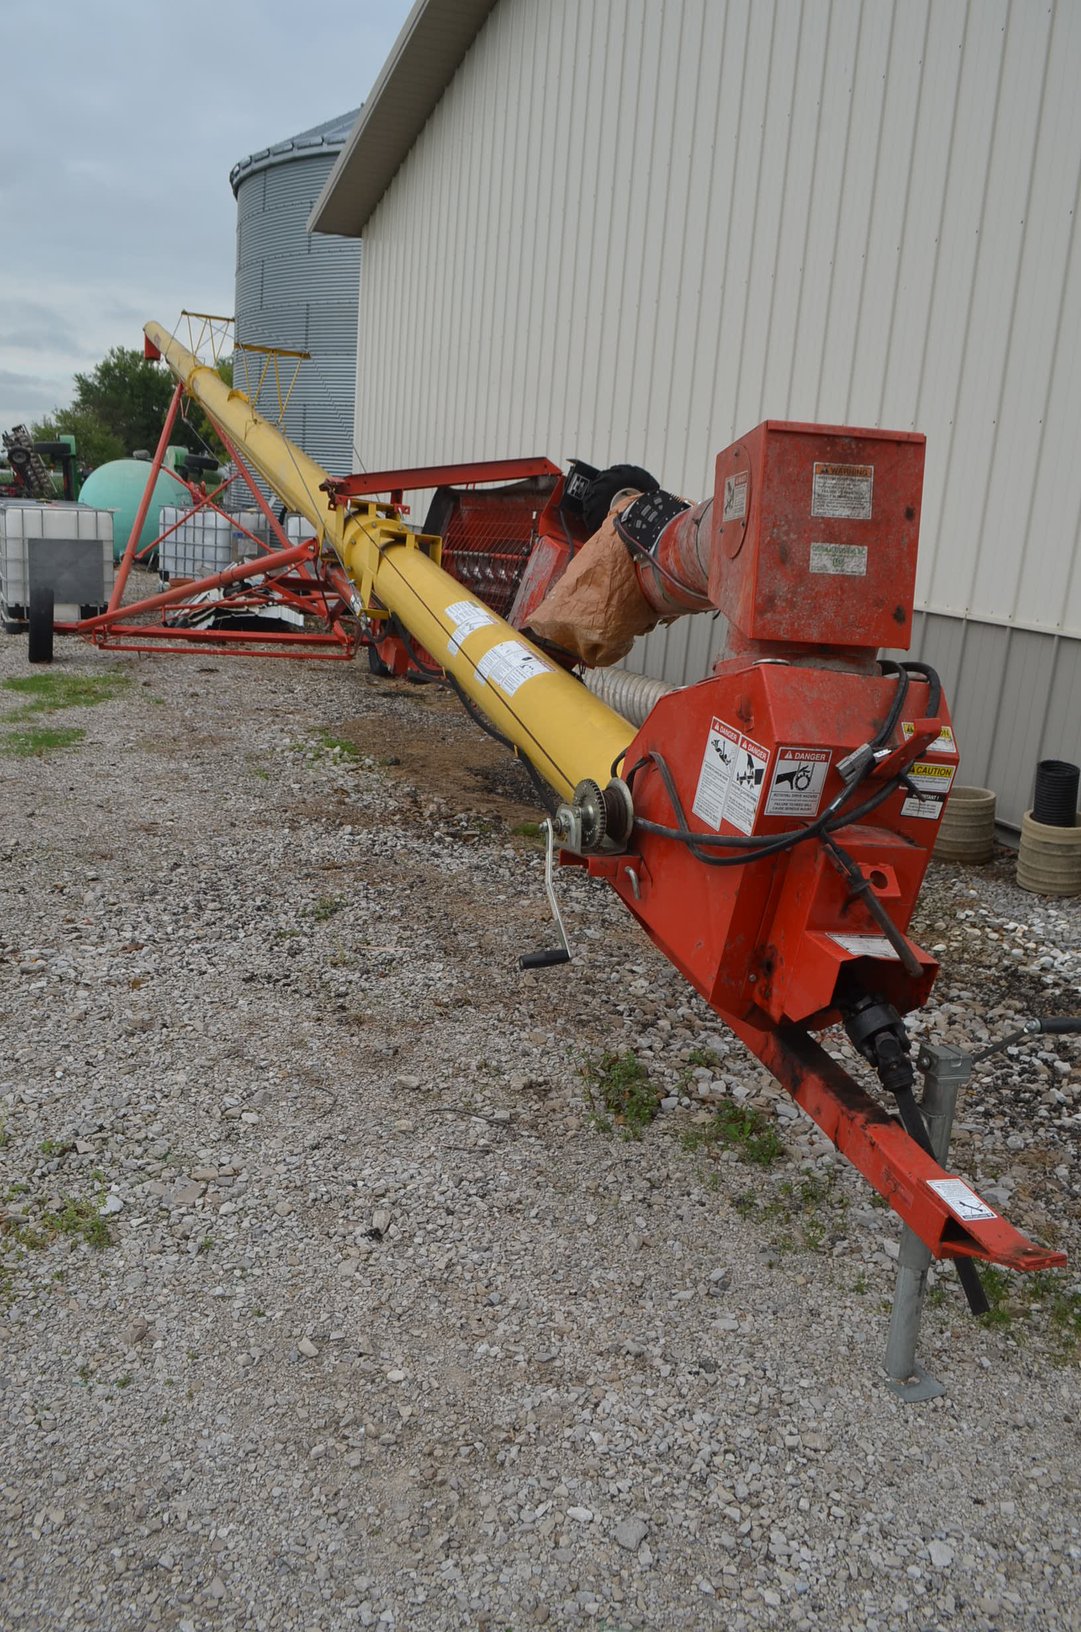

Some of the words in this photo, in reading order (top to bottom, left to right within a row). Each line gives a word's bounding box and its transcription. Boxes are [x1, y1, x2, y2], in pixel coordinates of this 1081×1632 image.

[720, 725, 738, 741] DANGER
[748, 743, 767, 760] DANGER
[794, 752, 826, 761] DANGER
[916, 766, 952, 777] CAUTION
